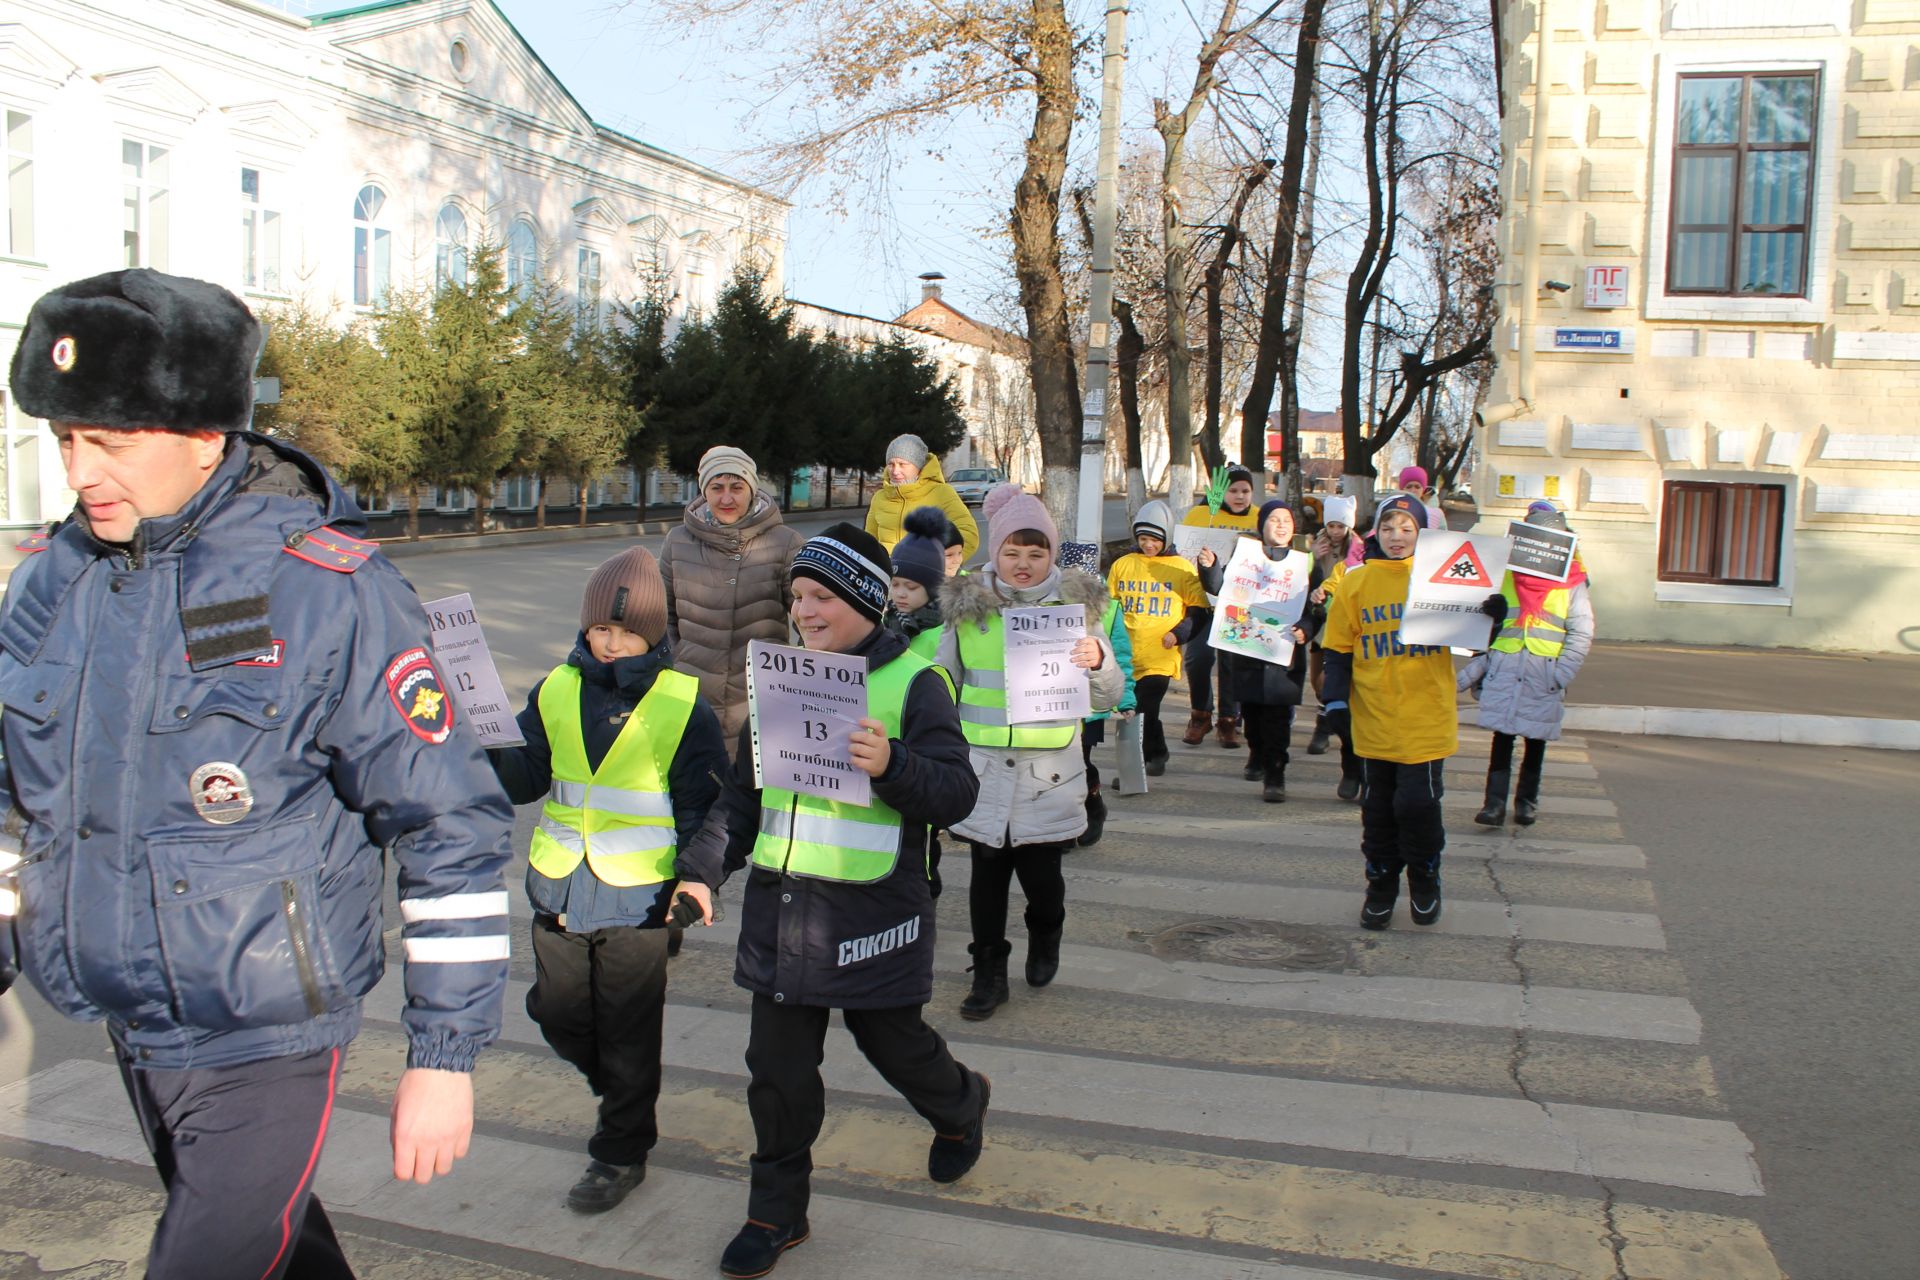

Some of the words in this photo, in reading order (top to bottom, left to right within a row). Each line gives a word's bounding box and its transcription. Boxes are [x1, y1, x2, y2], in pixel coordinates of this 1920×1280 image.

[1593, 269, 1623, 286] ПГ
[1569, 333, 1602, 343] Ленина
[1117, 580, 1173, 594] АКЦИЯ
[1120, 595, 1173, 617] ИБДД
[1361, 603, 1403, 624] АКЦ
[1413, 601, 1462, 612] БЕРЕГИТЕ
[448, 609, 478, 629] год
[1011, 615, 1050, 631] 2017
[1056, 616, 1085, 629] год
[434, 637, 480, 652] истопольском
[1023, 638, 1078, 647] Чистопольско
[388, 651, 427, 681] ПОЛИЦИЯ
[759, 651, 816, 677] 2015
[824, 666, 865, 688] год
[1041, 662, 1060, 677] 20
[398, 669, 435, 700] РОССИЯ
[455, 672, 476, 691] 12
[778, 683, 859, 705] Чистопольском
[1024, 686, 1080, 698] погибших
[464, 703, 501, 716] ибших
[801, 703, 838, 716] районе
[1043, 701, 1070, 713] ДТП
[803, 720, 828, 741] 13
[779, 749, 854, 772] погибших
[793, 773, 802, 782] в
[805, 772, 840, 790] ДТП
